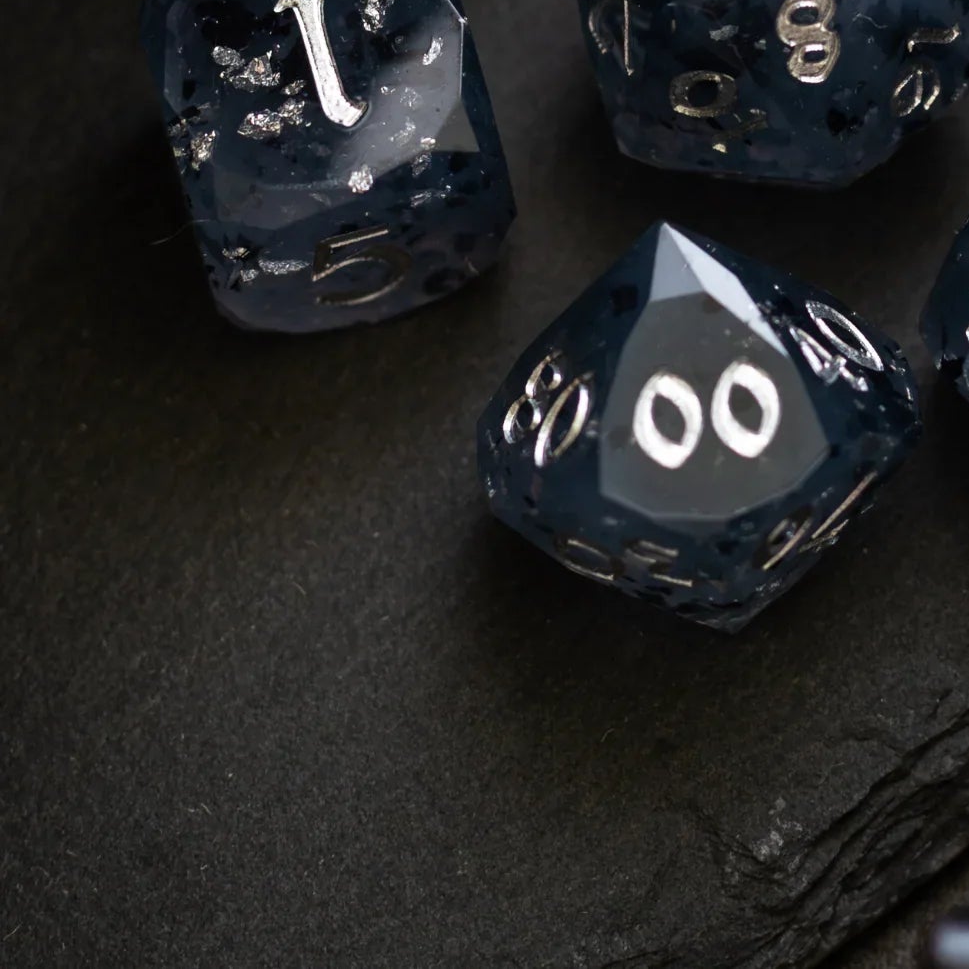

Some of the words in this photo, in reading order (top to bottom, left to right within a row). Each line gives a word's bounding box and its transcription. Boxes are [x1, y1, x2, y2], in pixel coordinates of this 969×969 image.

[312, 224, 412, 306] 5
[502, 349, 594, 468] 80
[633, 357, 781, 471] 00
